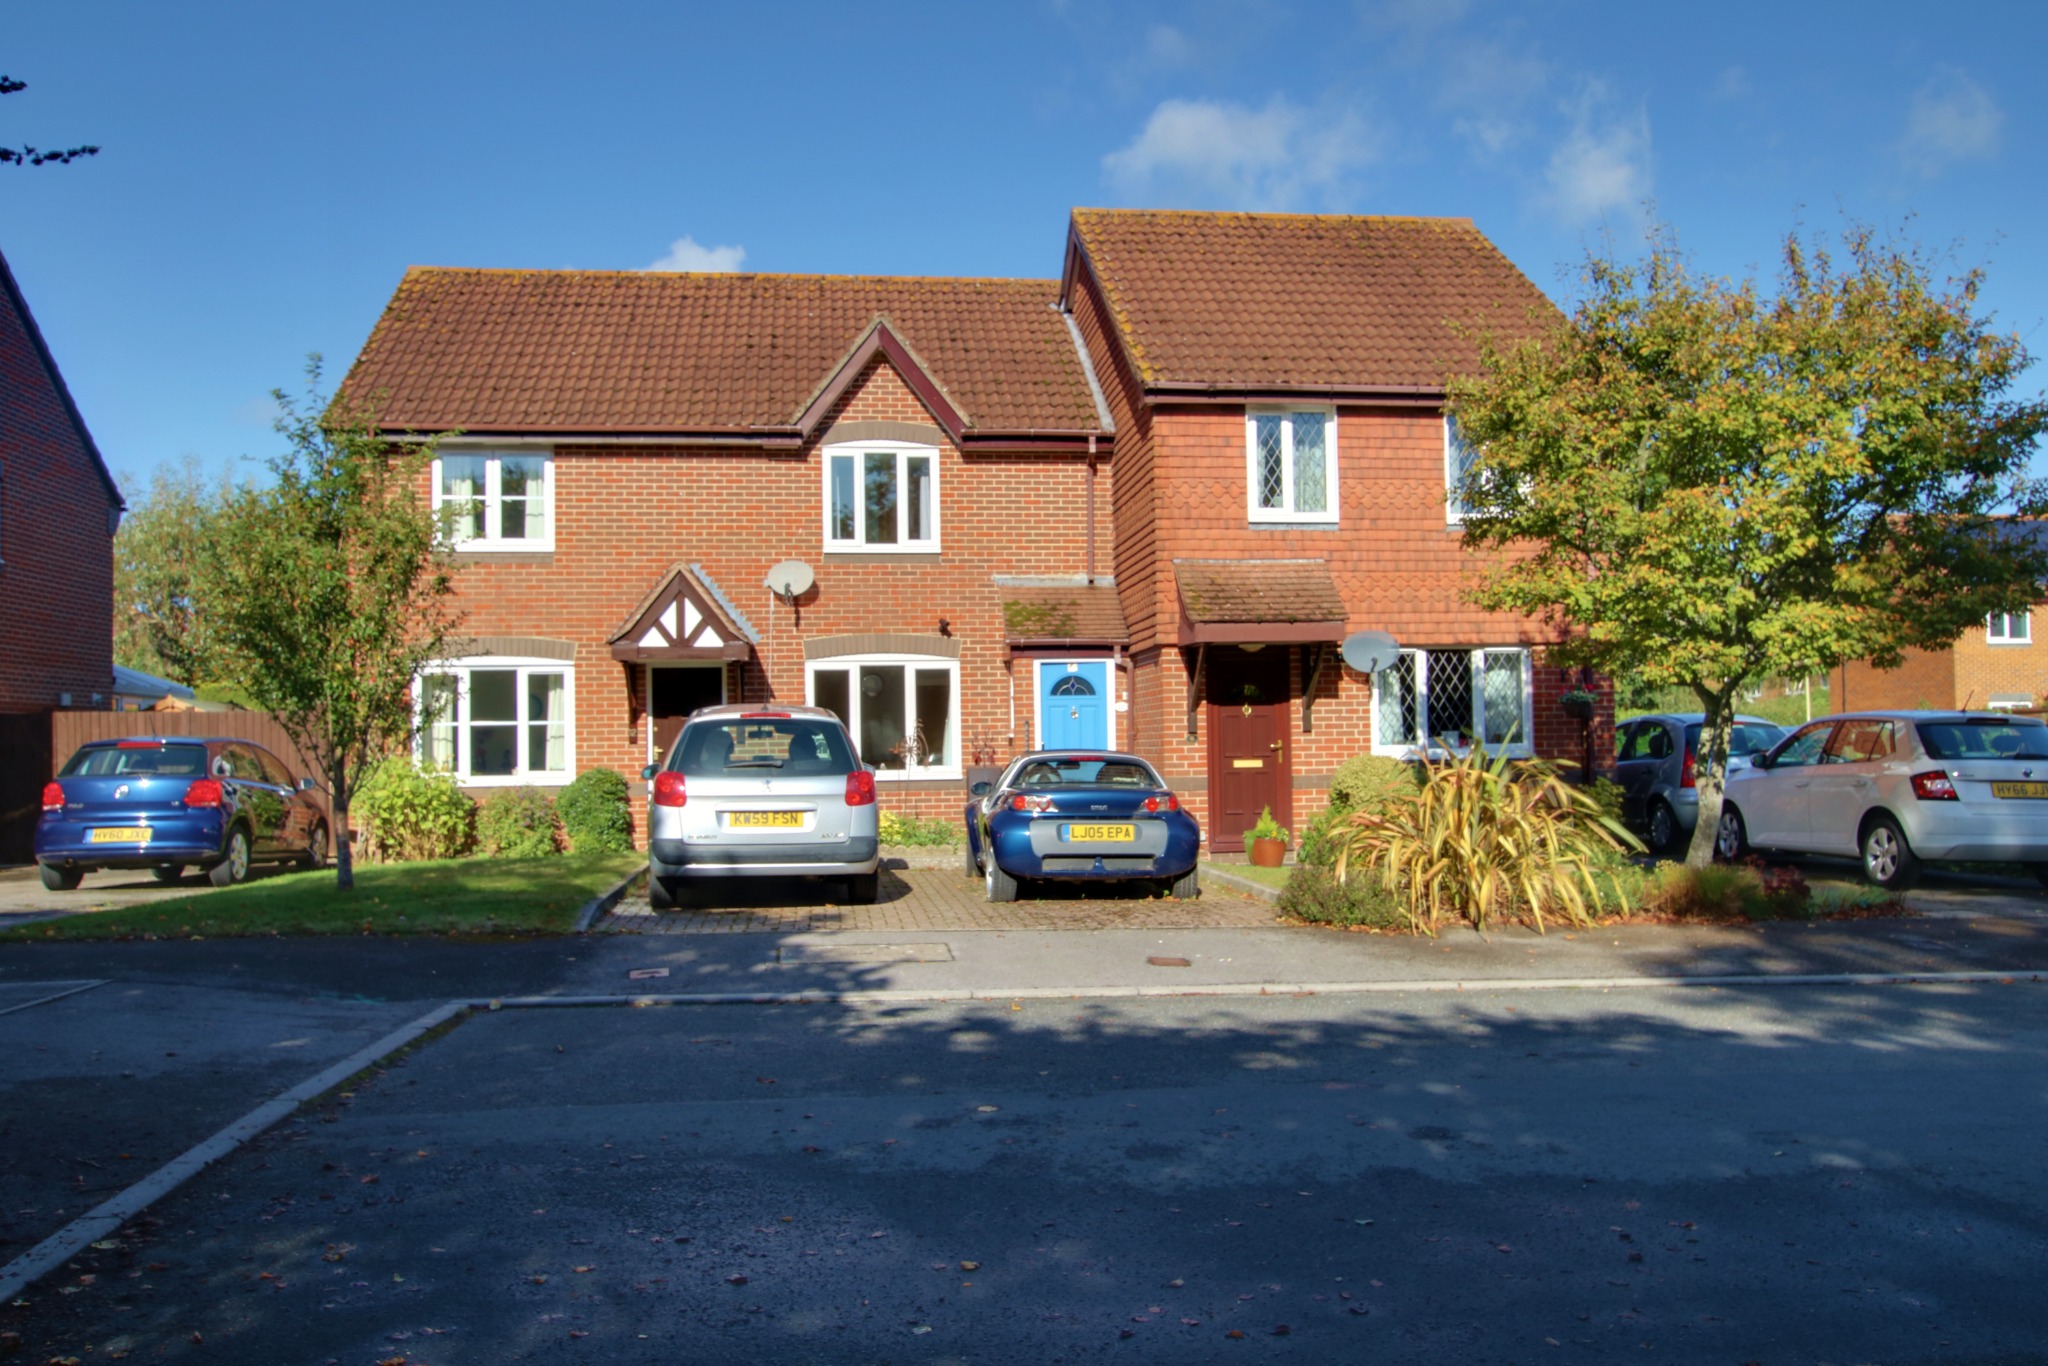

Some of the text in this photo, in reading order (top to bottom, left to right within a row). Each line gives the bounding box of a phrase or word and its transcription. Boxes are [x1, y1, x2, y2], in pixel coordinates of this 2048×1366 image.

[1997, 784, 2028, 796] HY66
[734, 812, 799, 824] KW59 FSN
[94, 829, 150, 840] HV60 JXC
[1072, 827, 1131, 838] LJ05 EPA
